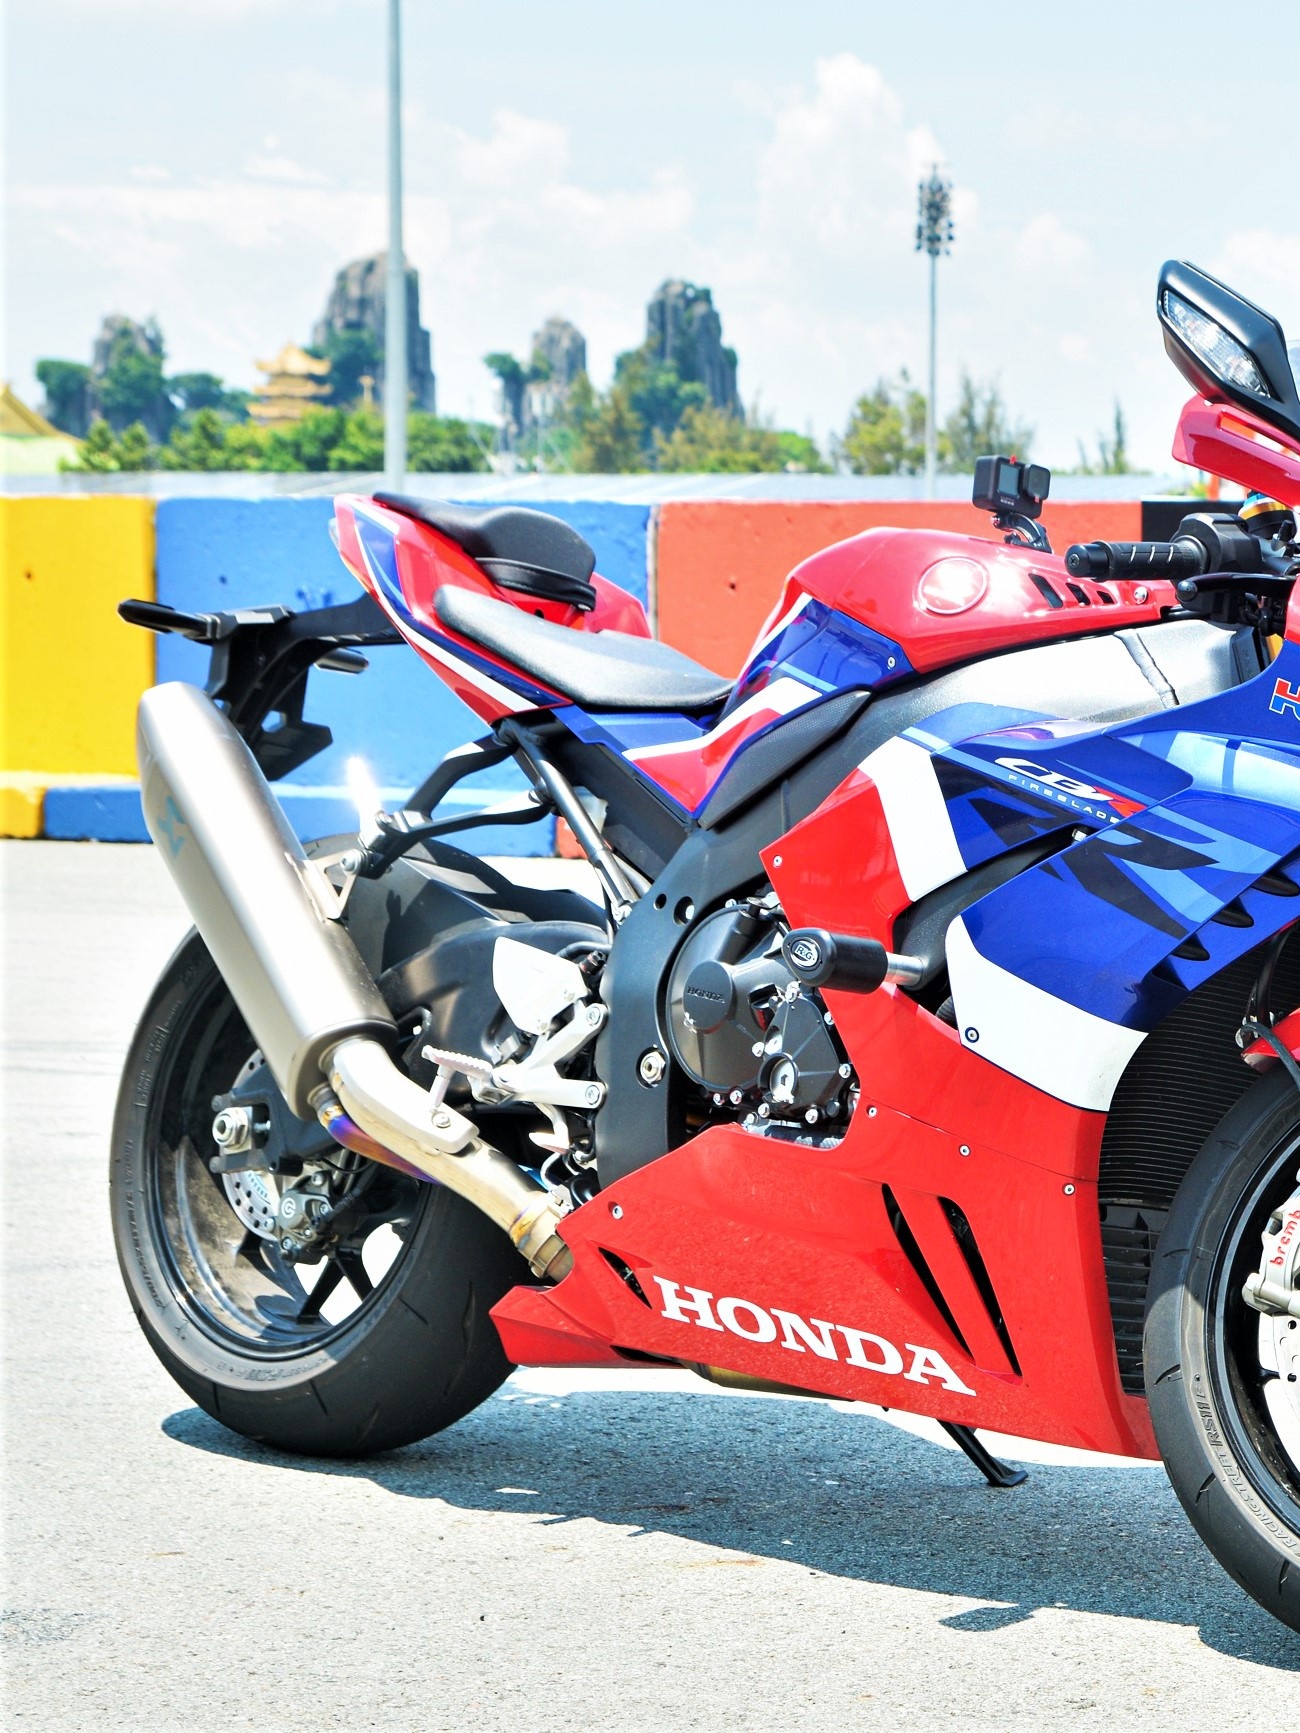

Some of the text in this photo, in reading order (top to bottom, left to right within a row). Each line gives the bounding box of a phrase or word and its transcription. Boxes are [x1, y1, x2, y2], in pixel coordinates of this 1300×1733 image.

[994, 757, 1148, 818] CBR
[1008, 773, 1122, 825] FIREBLADE
[686, 985, 726, 1004] HONDA
[652, 1275, 977, 1397] HONDA
